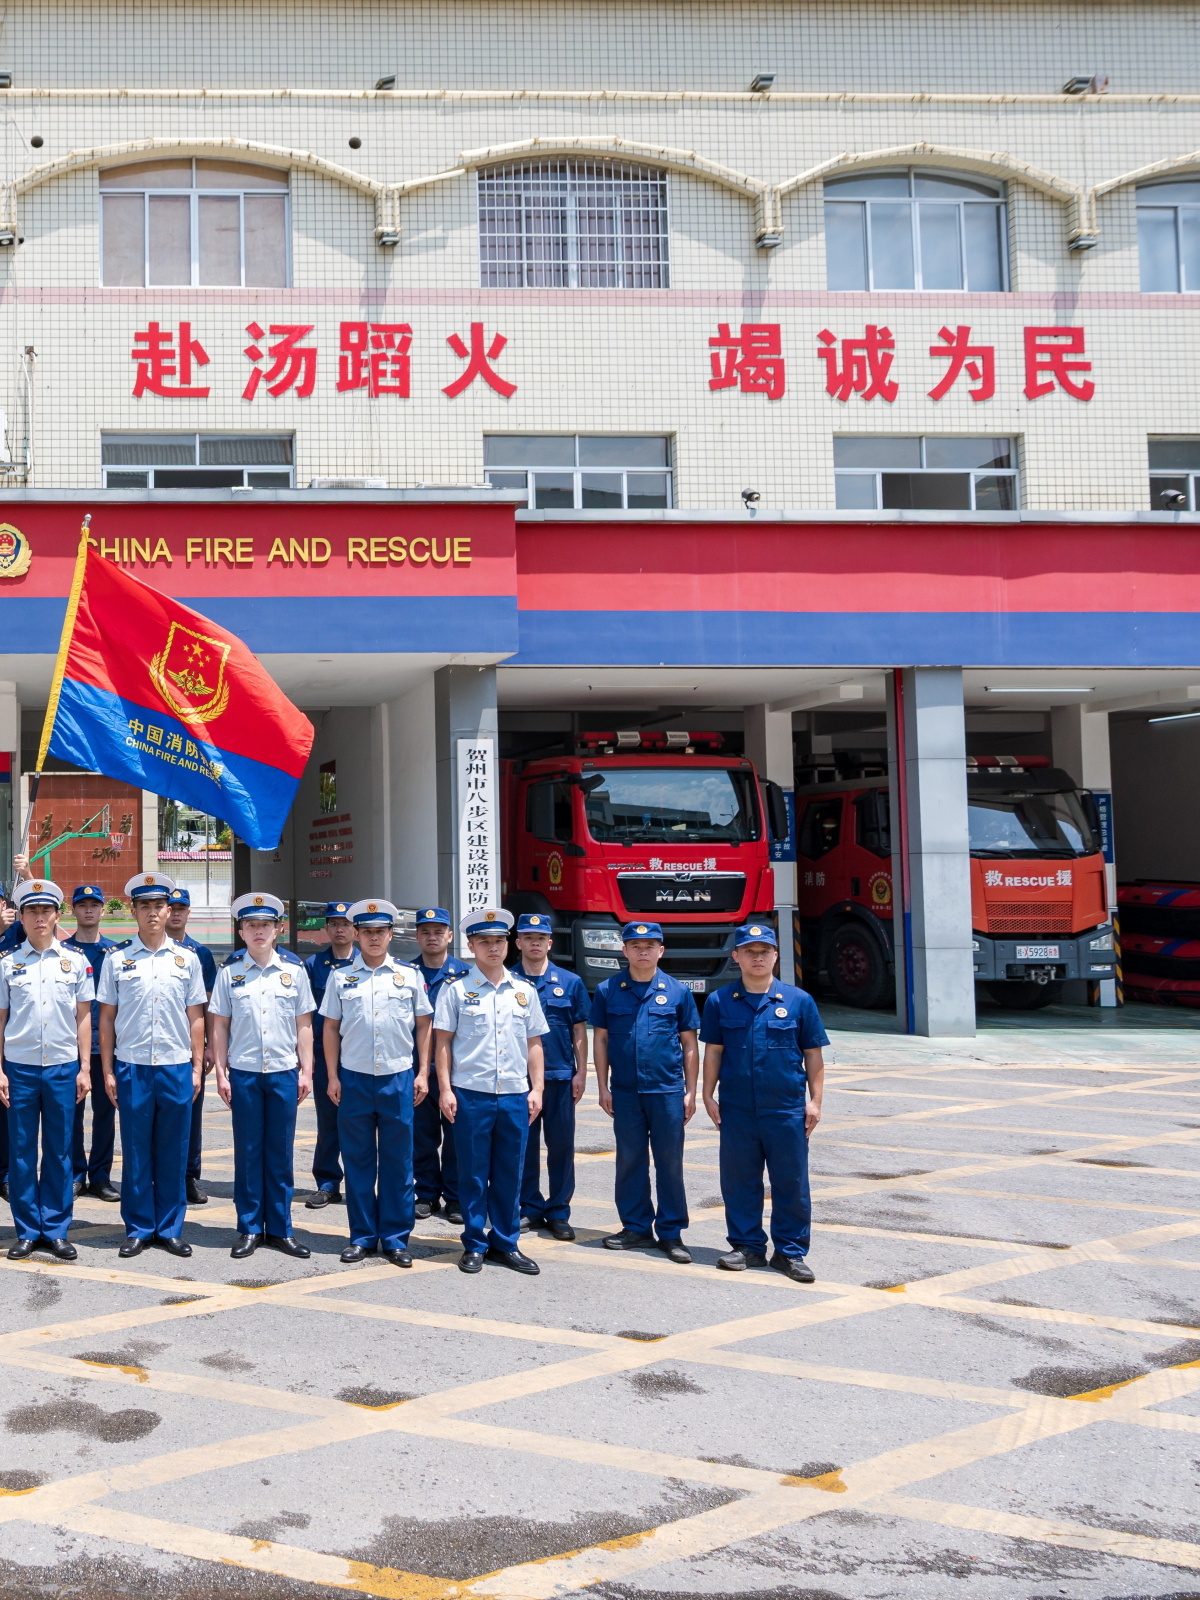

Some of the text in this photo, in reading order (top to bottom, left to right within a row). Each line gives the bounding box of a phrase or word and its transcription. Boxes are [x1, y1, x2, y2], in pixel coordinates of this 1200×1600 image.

[132, 322, 518, 400] 赴汤蹈火
[709, 324, 1095, 402] 竭诚为民
[186, 537, 255, 563] FIRE
[267, 537, 332, 562] AND
[348, 536, 473, 563] RESCUE
[125, 736, 154, 755] CHINA
[155, 748, 178, 765] FIRE
[177, 758, 199, 772] AND
[649, 857, 717, 871] 救 RESCUE 援
[804, 872, 825, 886] 消防
[985, 869, 1073, 887] 救 RESCUE 援
[656, 890, 712, 902] MAN
